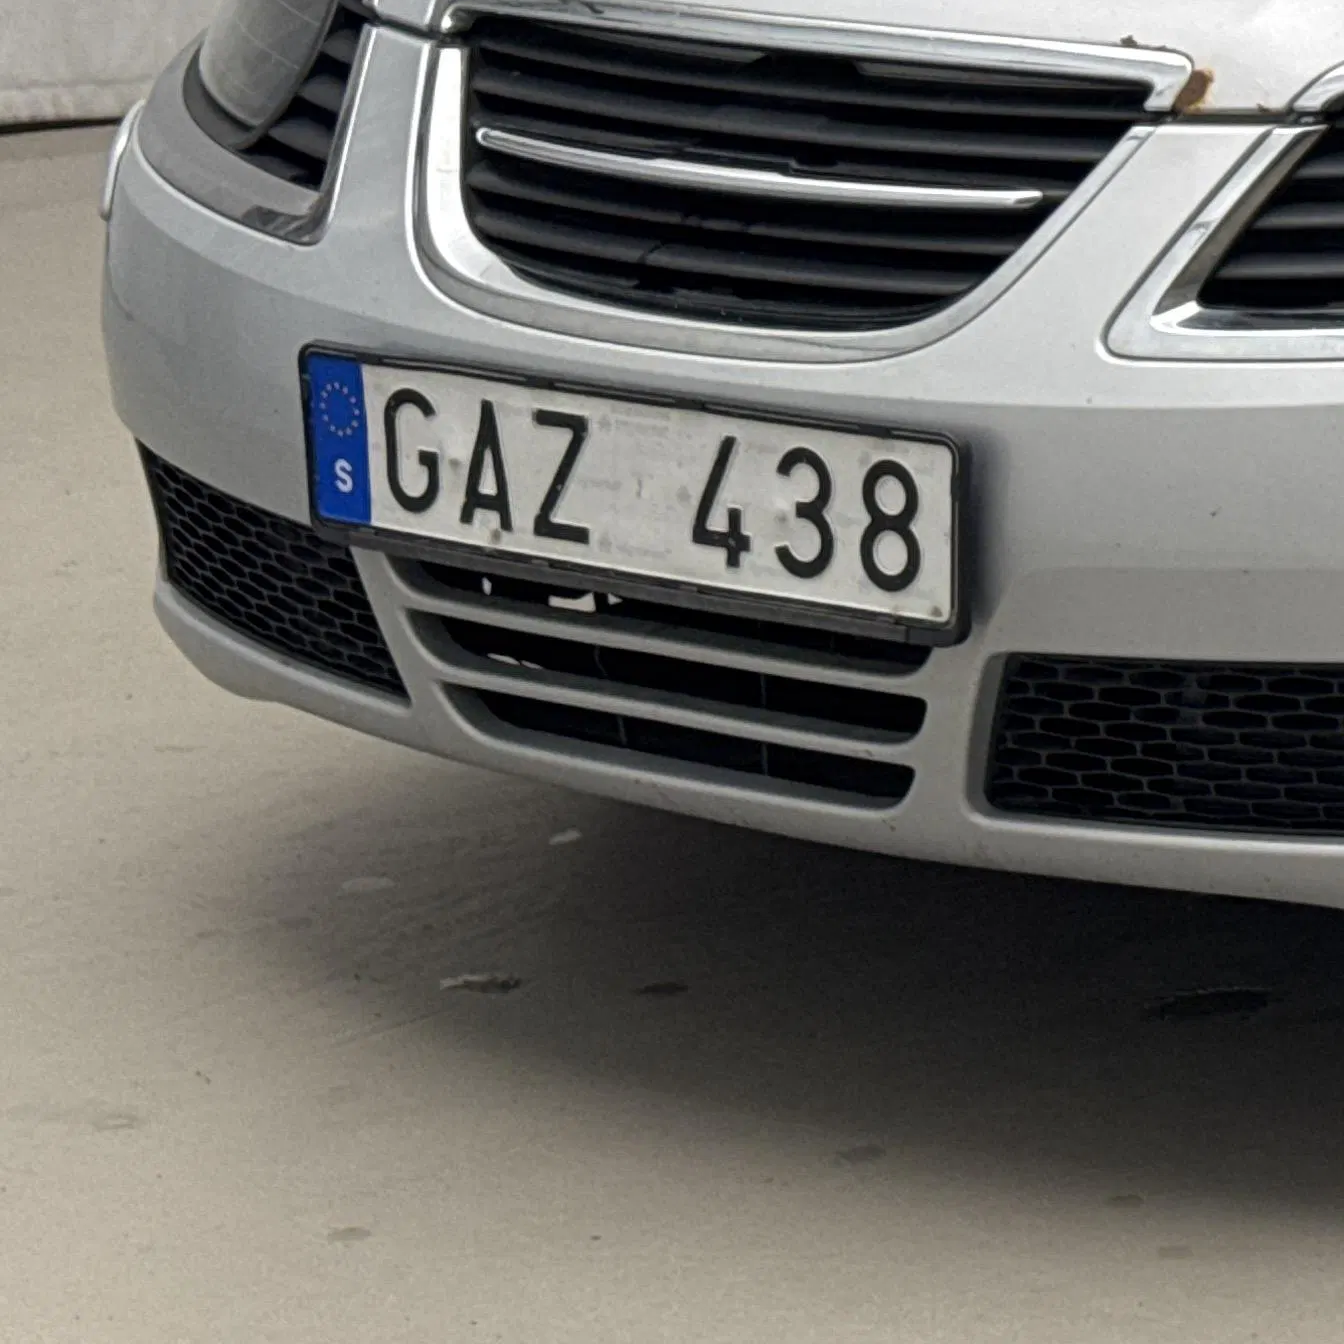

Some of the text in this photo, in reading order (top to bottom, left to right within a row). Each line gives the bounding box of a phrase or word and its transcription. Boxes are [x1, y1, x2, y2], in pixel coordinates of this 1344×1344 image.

[334, 459, 354, 493] S
[384, 387, 921, 592] GAZ 438
